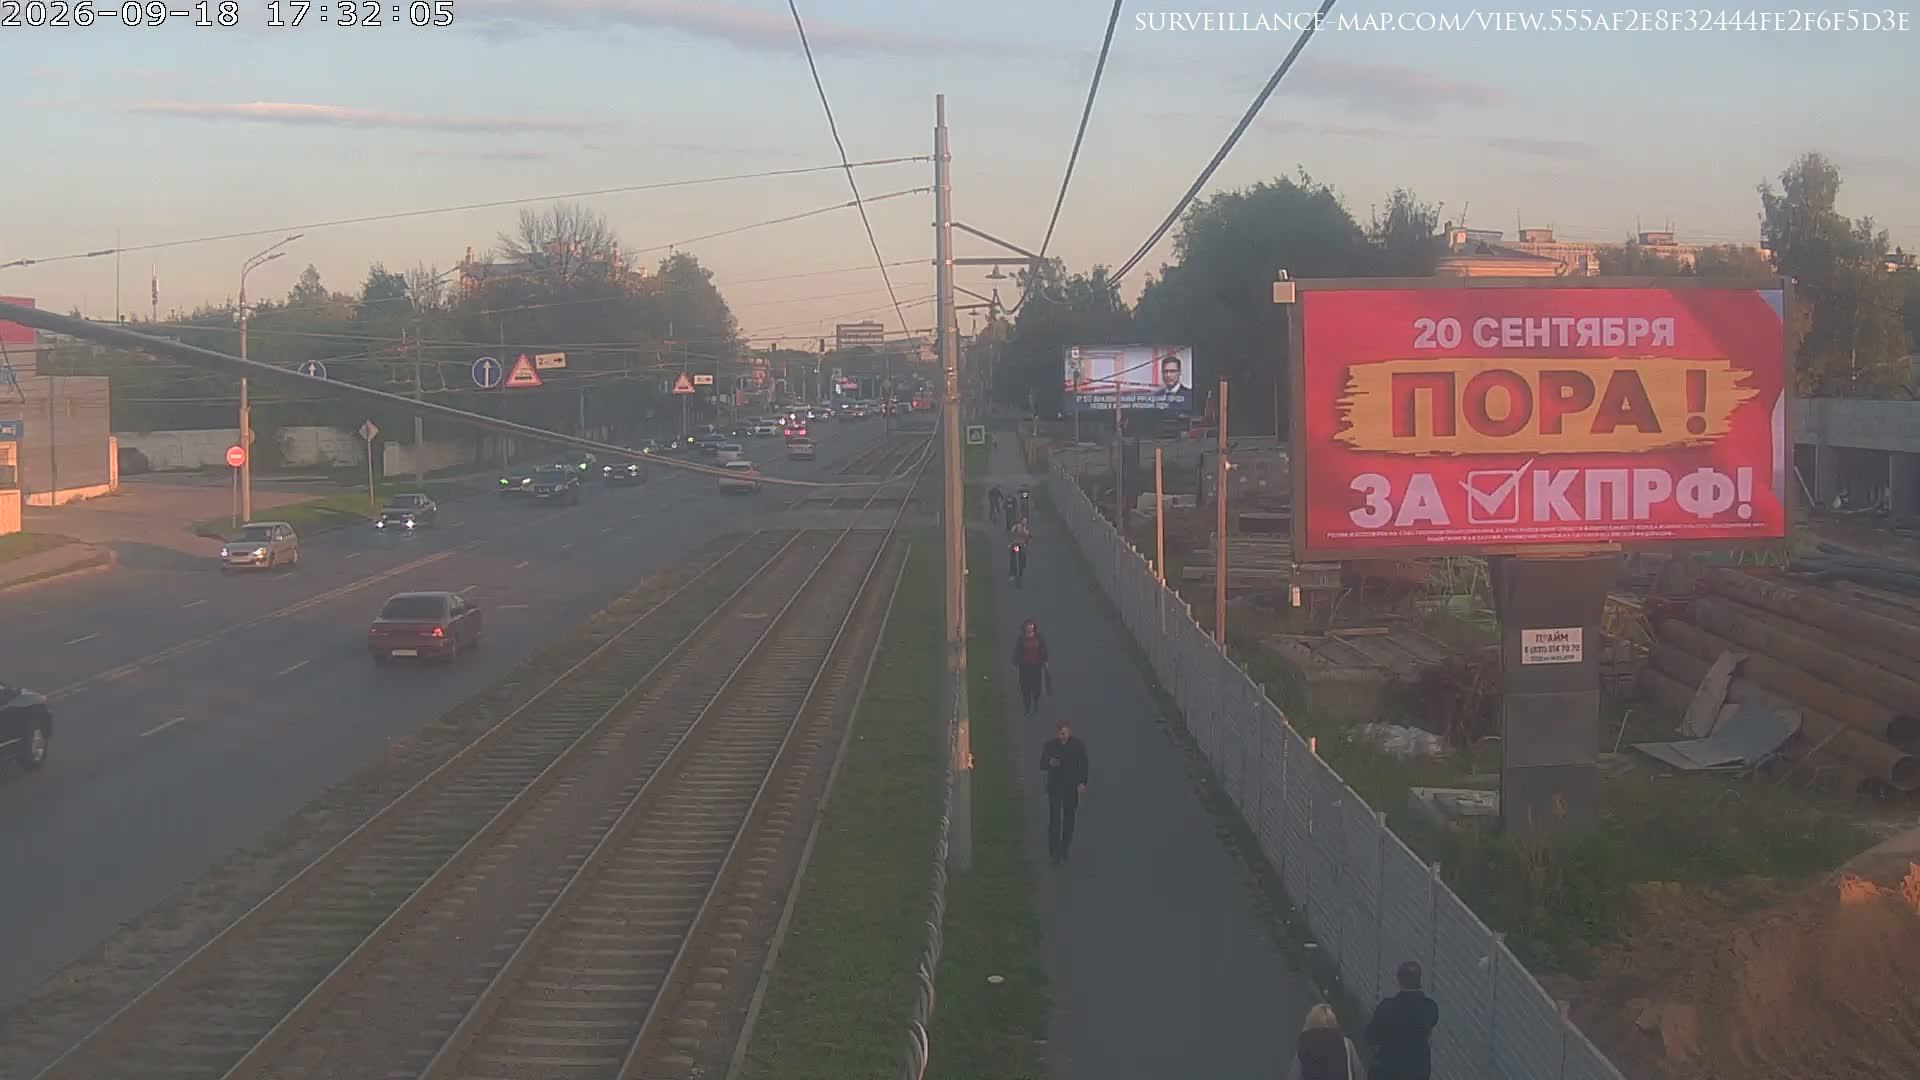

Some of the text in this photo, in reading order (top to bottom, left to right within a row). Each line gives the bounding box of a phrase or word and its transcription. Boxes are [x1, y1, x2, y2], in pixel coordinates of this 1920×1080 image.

[1413, 316, 1675, 349] 20 СЕНТЯБРЯ
[1391, 369, 1662, 438] ПОРА
[1349, 466, 1753, 529] ЗА КПРФ!
